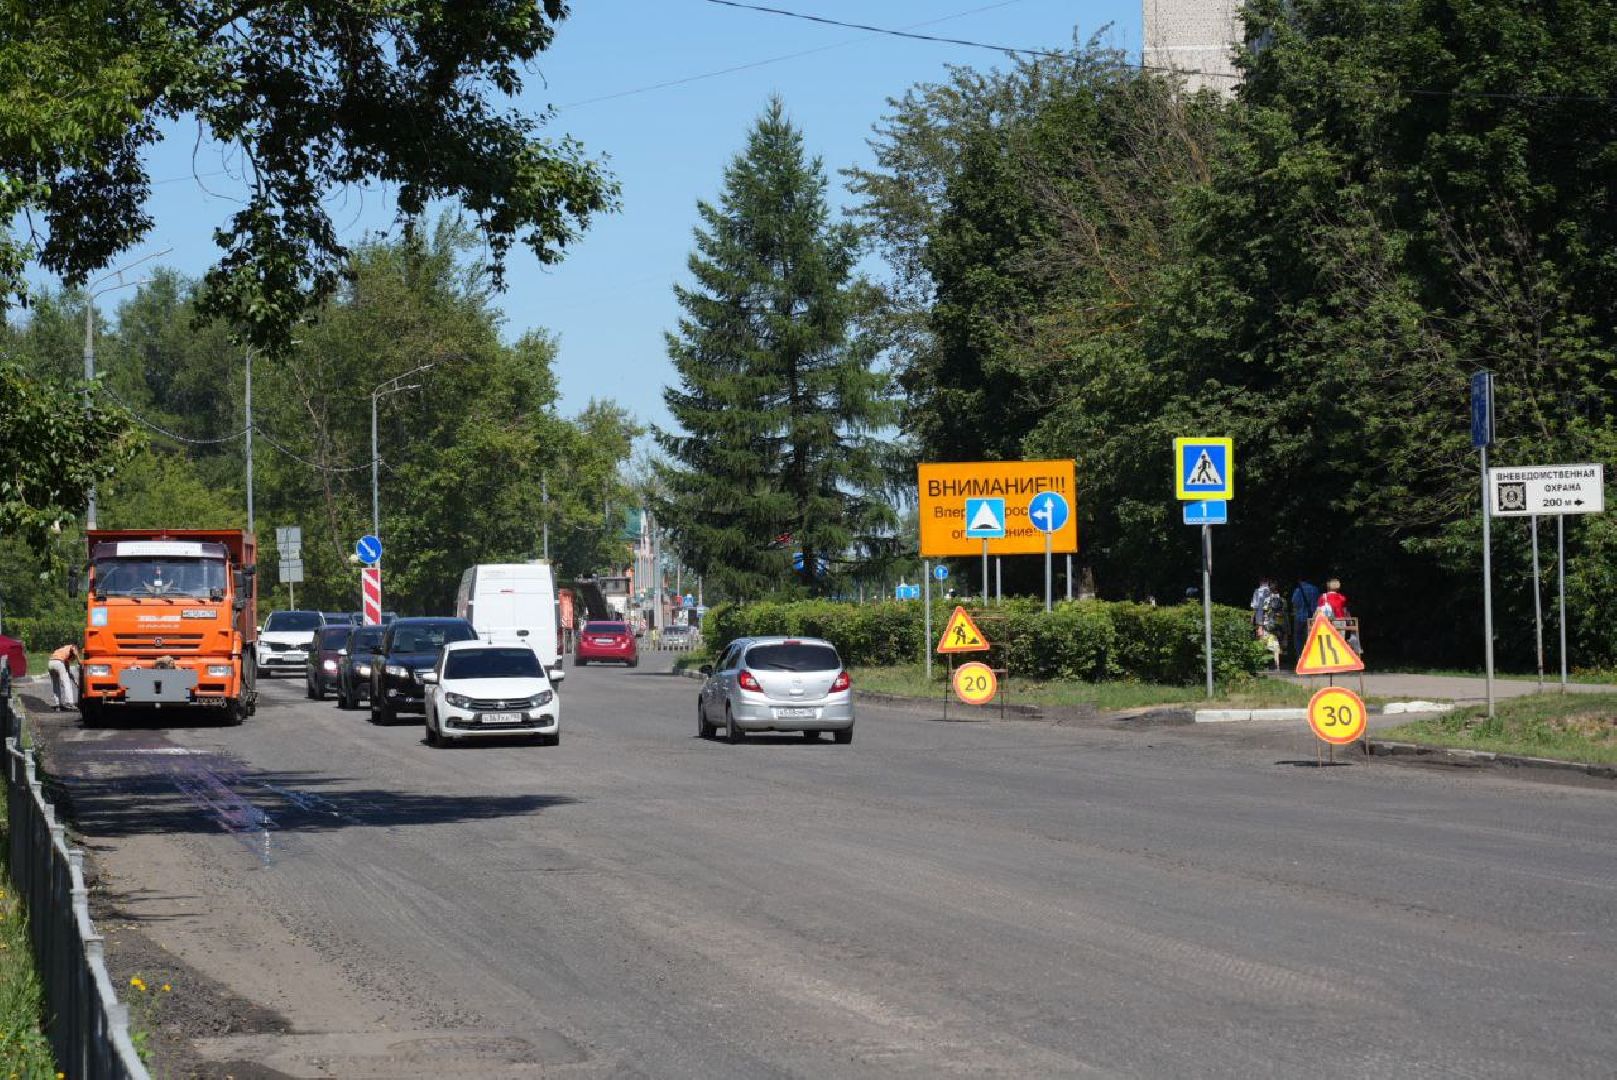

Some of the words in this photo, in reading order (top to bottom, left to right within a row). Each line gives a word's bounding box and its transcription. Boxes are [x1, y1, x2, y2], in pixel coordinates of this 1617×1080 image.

[1496, 468, 1595, 481] ВНЕВЕДОМСТВЕННАЯ
[928, 476, 1066, 497] ВНИМАНИЕ!!!
[1544, 483, 1582, 493] ОХРАНА
[1542, 498, 1562, 507] 200
[964, 676, 987, 691] 20
[1322, 705, 1352, 726] 30
